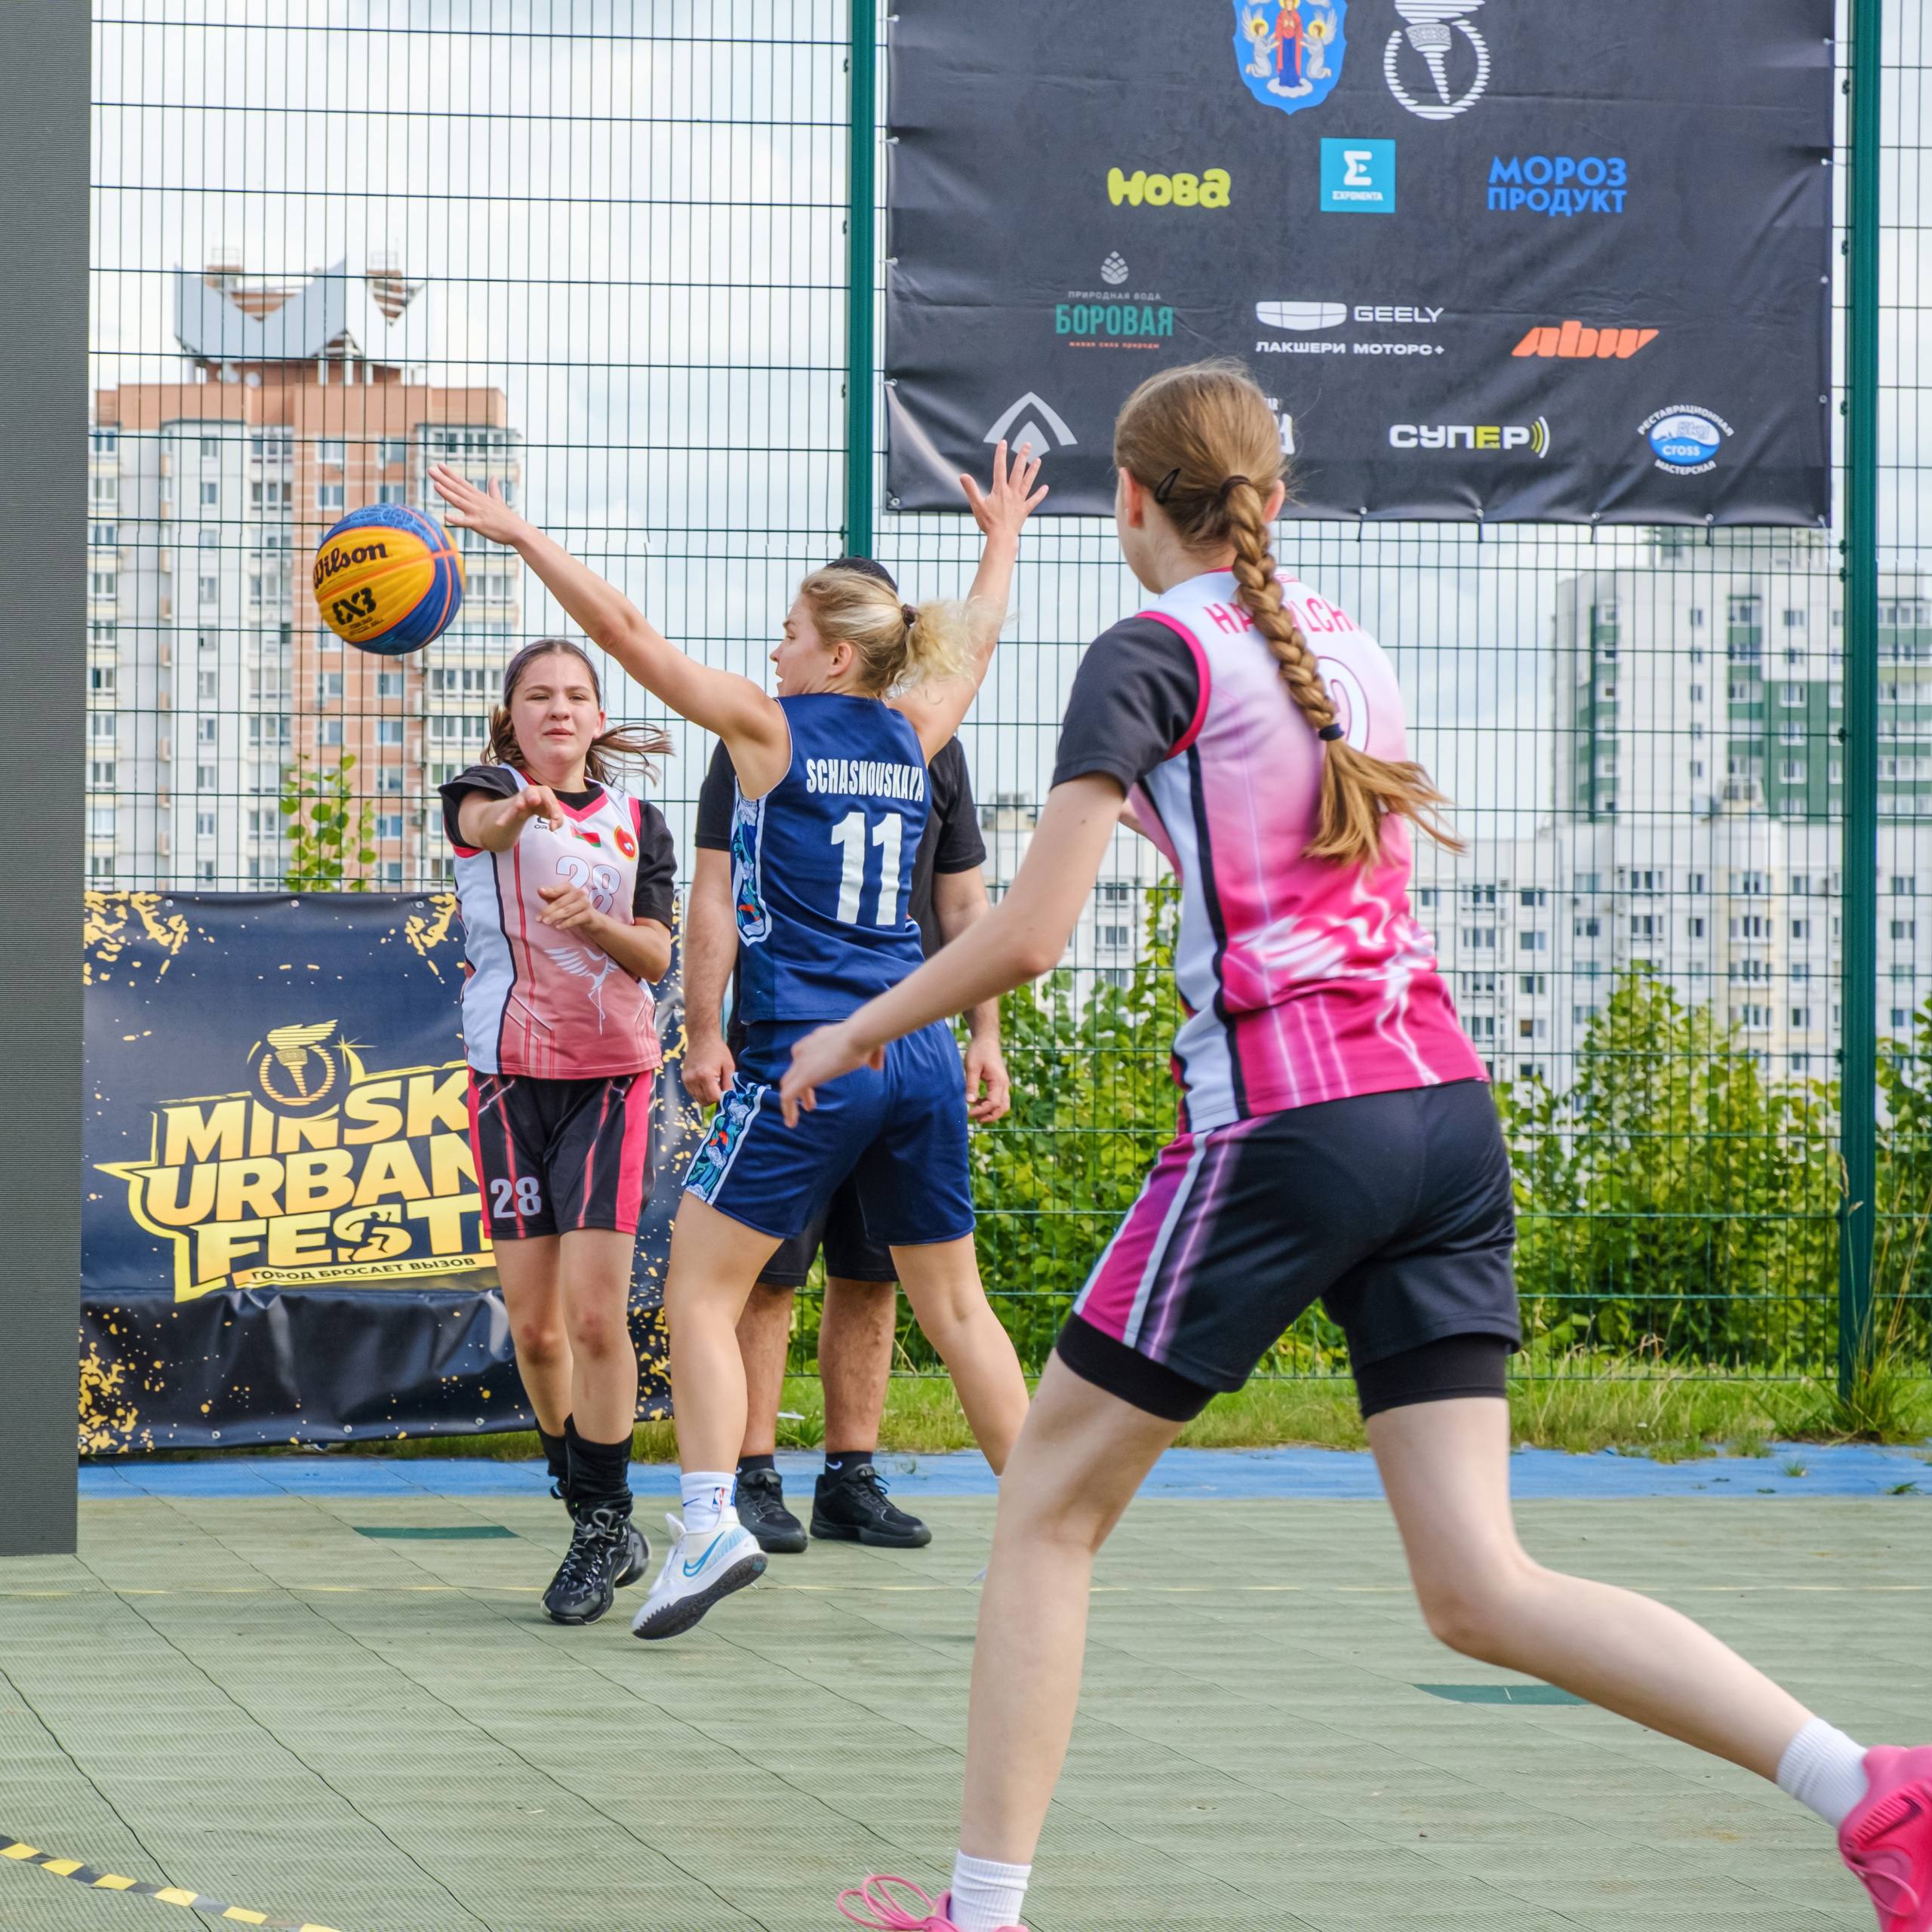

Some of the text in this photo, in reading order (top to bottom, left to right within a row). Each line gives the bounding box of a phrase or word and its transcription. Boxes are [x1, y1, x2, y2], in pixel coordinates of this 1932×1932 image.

[1488, 155, 1628, 187] МОРОЗ
[1487, 186, 1628, 217] ПРОДУКТ
[1068, 291, 1161, 301] ПРИРОДНАЯ ВОДА
[1056, 304, 1174, 336] БОРОВАЯ
[1354, 306, 1444, 323] GEELY
[1255, 341, 1346, 354] ЛАКШЕРИ
[1389, 424, 1531, 450] СУПЕР
[1637, 405, 1734, 437] РЕСТАВРАЦИОННАЯ
[1654, 459, 1717, 475] МАСТЕРСКАЯ
[313, 543, 388, 589] Wilson
[806, 758, 924, 802] SCHASNOUSKAYA
[831, 811, 902, 926] 11
[556, 855, 621, 915] 28
[162, 1069, 470, 1166] MINSK
[133, 1133, 479, 1226] URBAN
[491, 1177, 542, 1219] 28
[189, 1192, 482, 1283] FEST
[251, 1257, 476, 1281] ГОРОД БРОСАЕТ ВЫЗОВ
